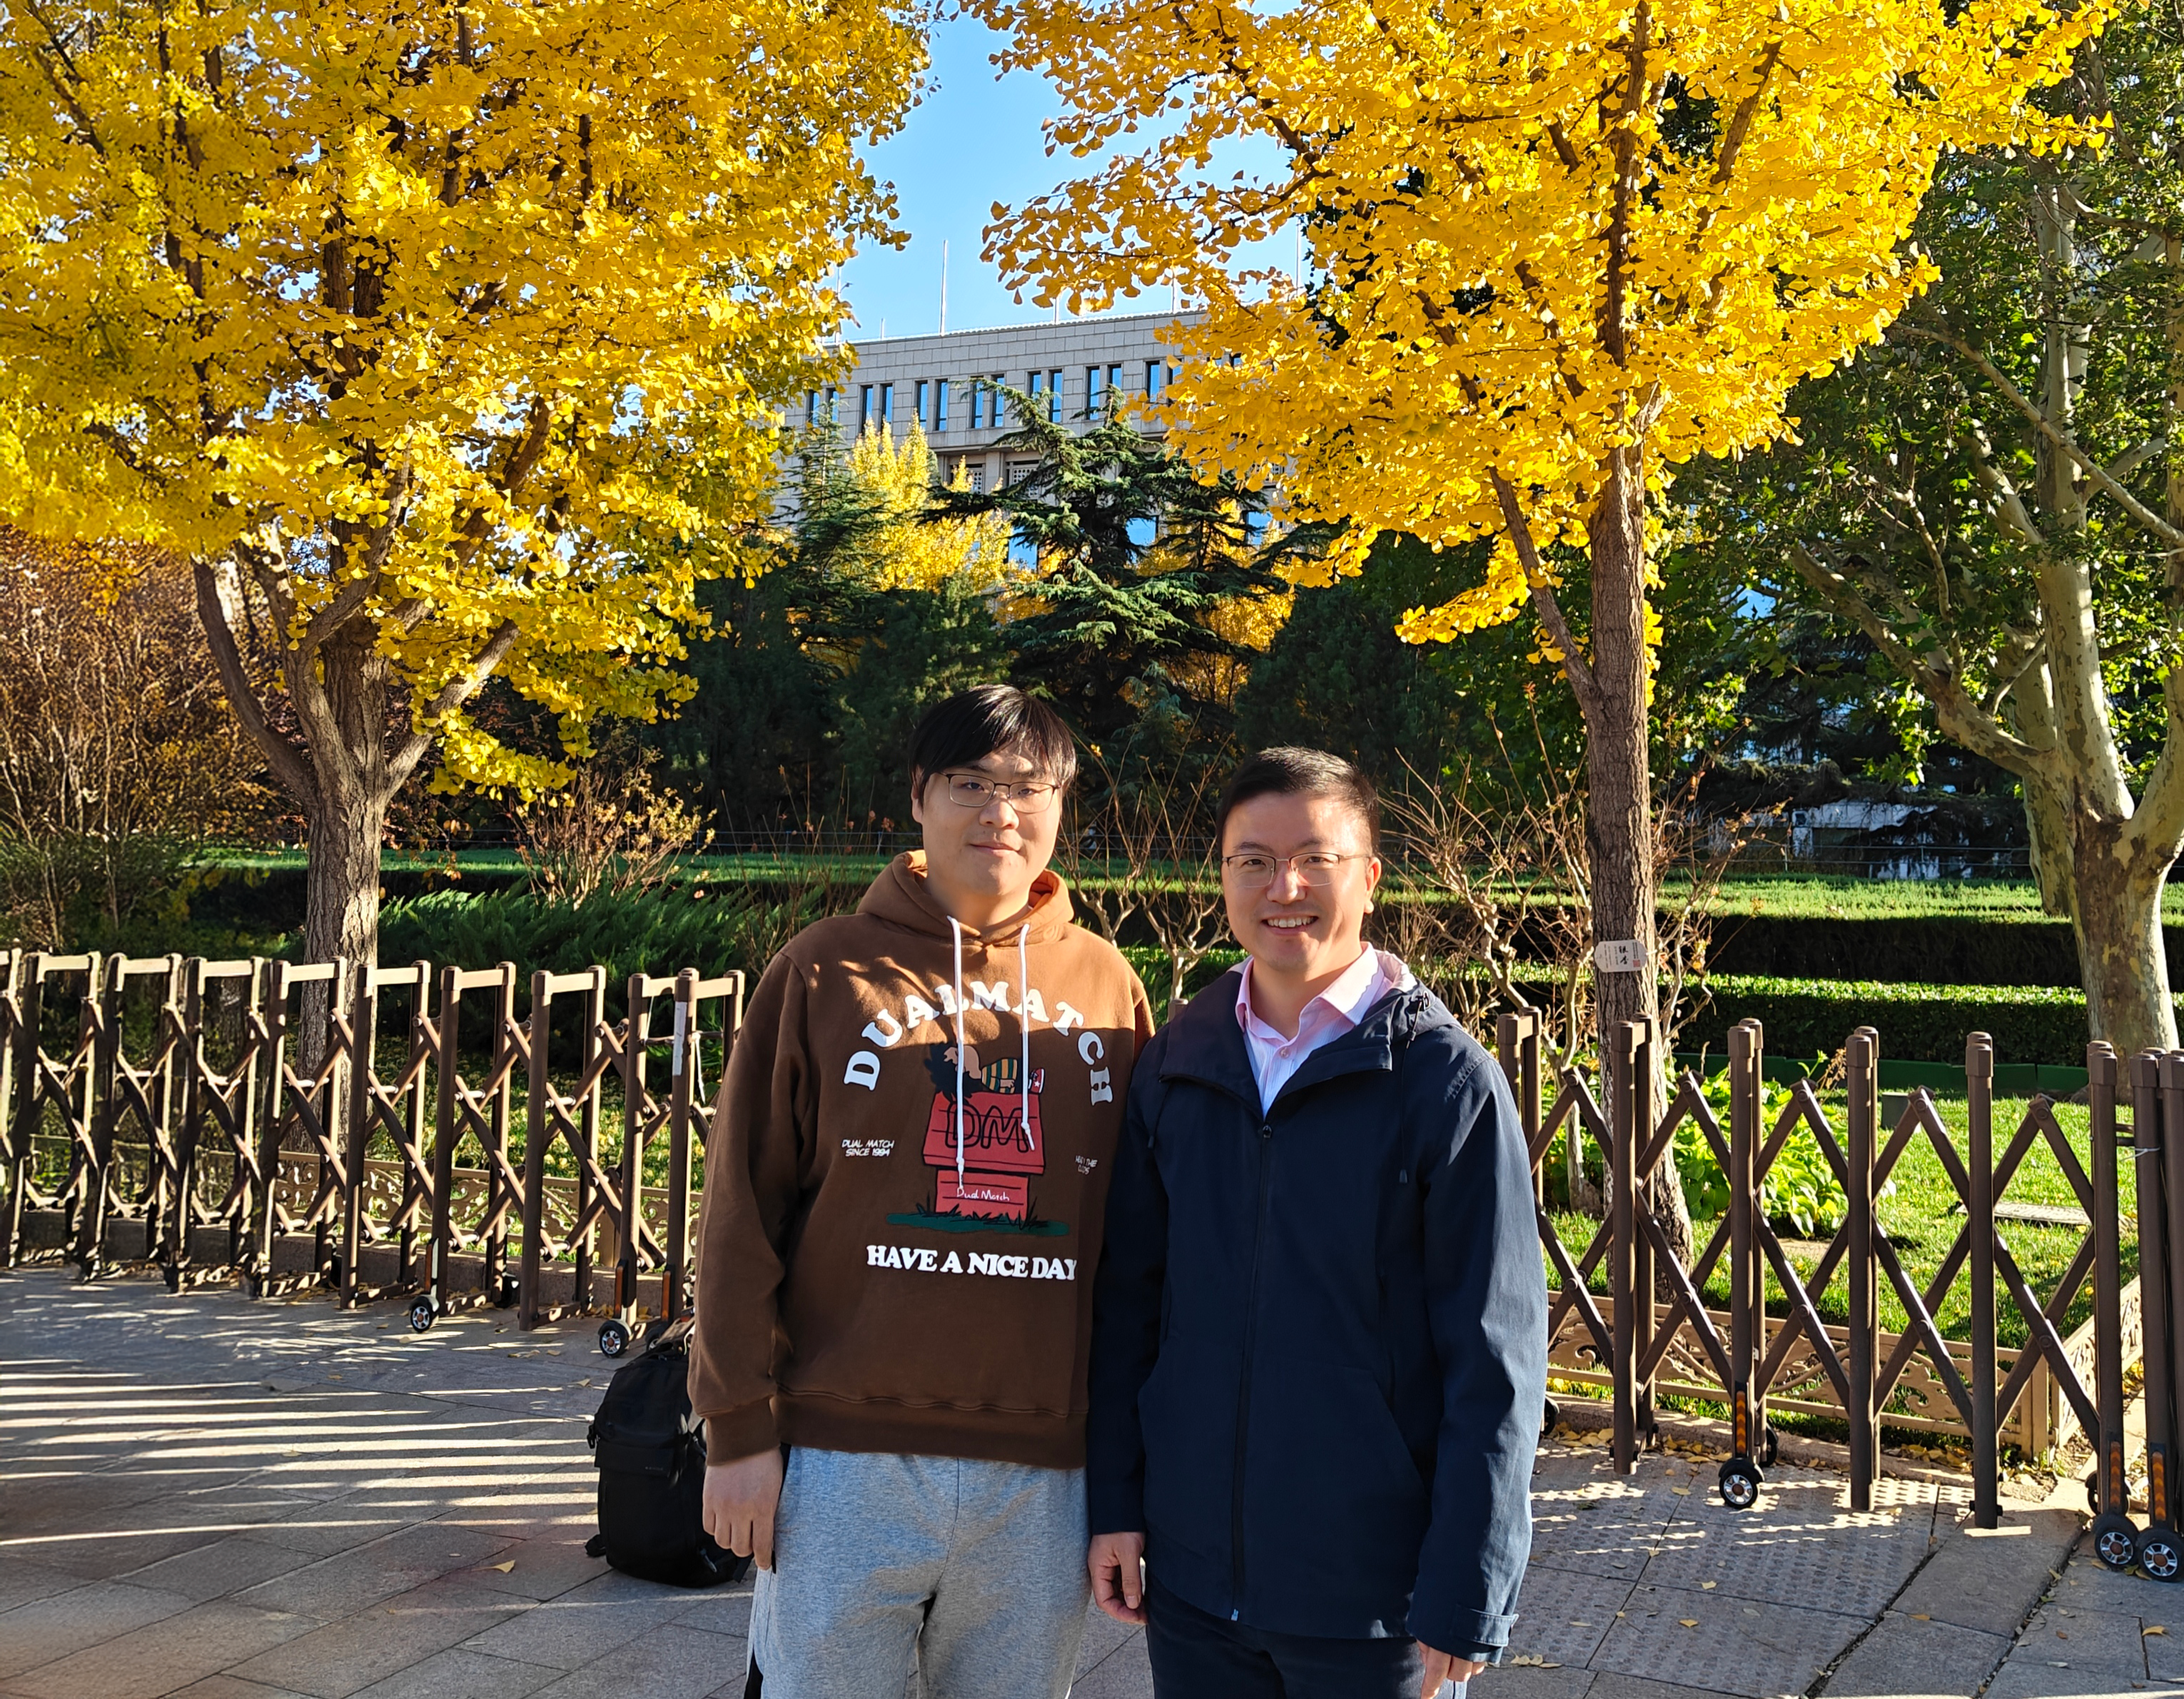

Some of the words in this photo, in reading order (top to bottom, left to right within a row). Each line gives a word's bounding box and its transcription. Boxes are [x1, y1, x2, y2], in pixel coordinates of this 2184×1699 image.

[945, 1101, 1030, 1153] DM
[841, 1139, 864, 1148] DUAL
[865, 1139, 895, 1149] MATCH
[845, 1148, 871, 1156] SINCE
[866, 1245, 938, 1272] HAVE
[940, 1251, 964, 1274] A
[967, 1252, 1028, 1278] NICE
[1031, 1257, 1077, 1280] DAY
